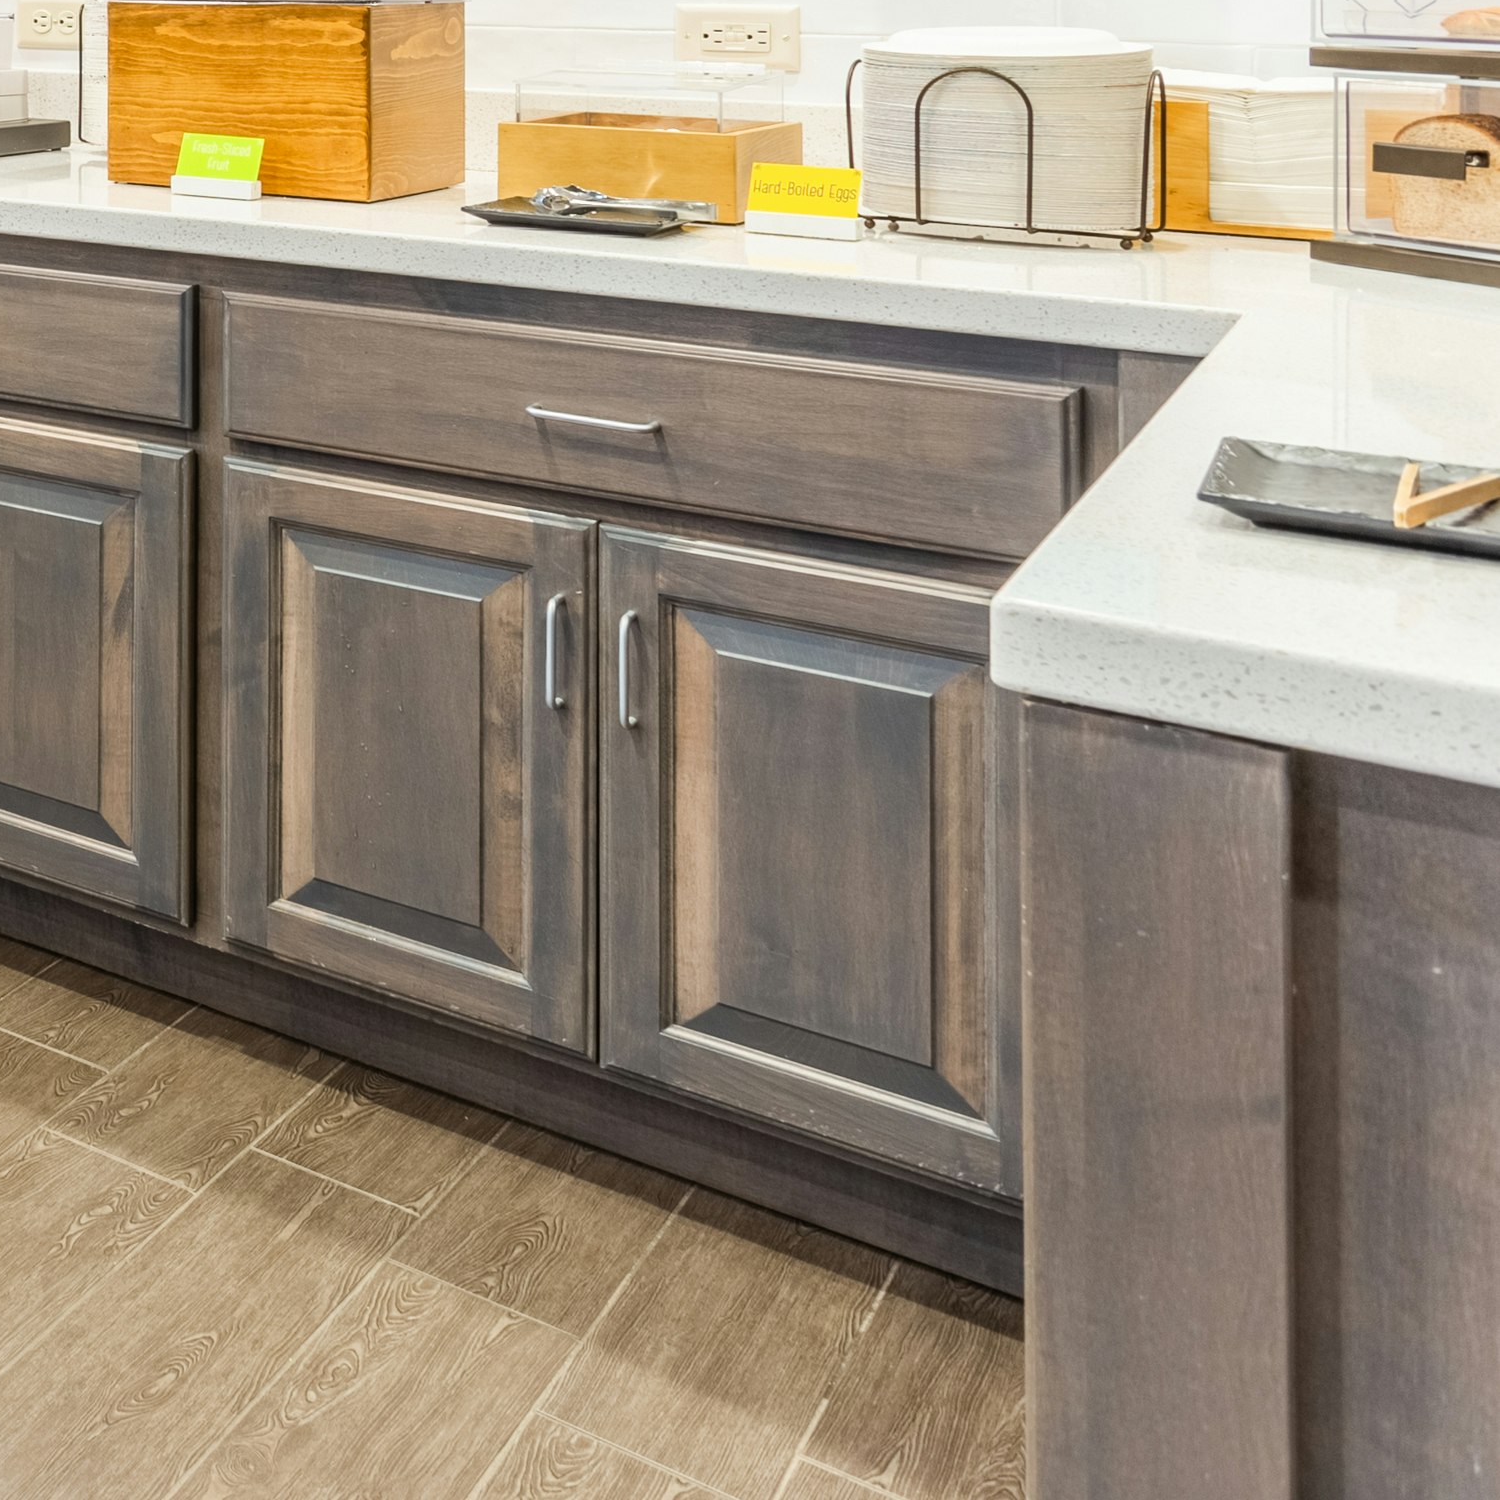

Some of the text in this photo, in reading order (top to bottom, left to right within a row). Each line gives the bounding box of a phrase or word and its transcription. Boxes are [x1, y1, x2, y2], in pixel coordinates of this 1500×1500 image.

[207, 157, 230, 171] Fruit
[753, 180, 857, 203] Hard-Boiled Eggs
